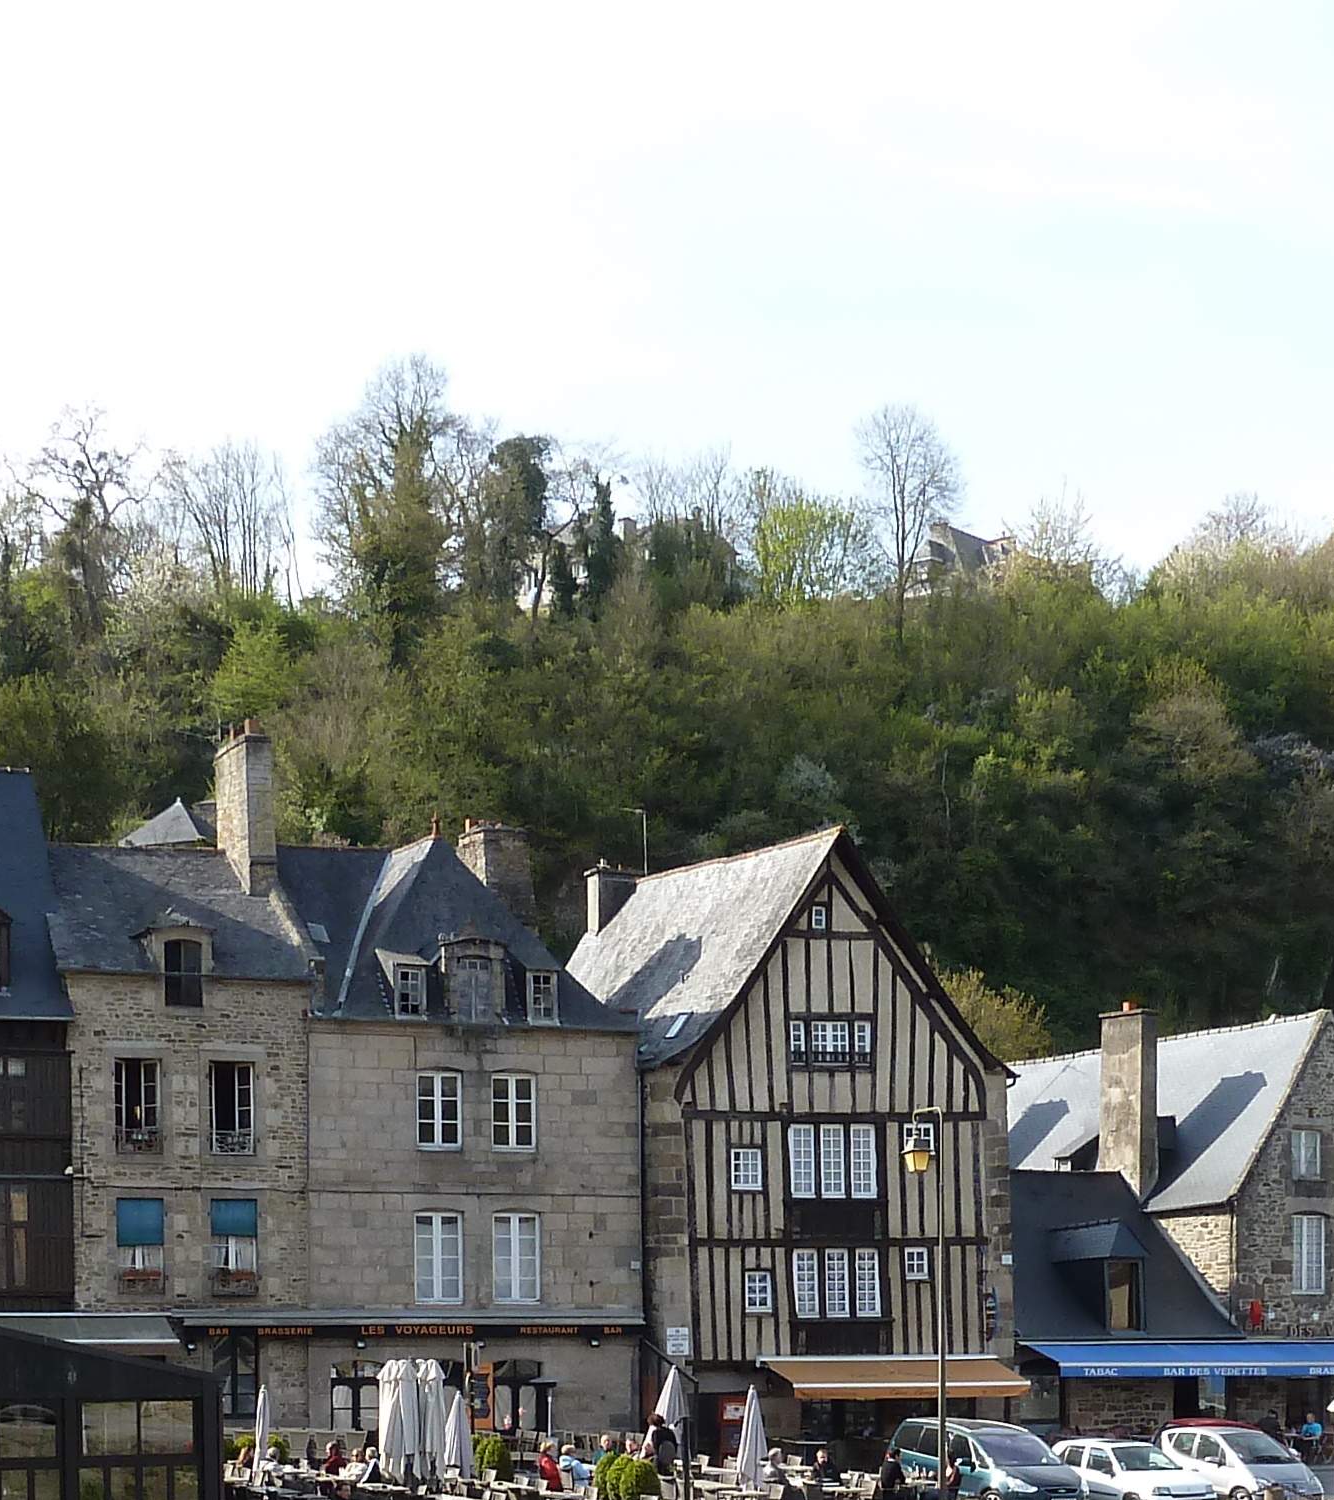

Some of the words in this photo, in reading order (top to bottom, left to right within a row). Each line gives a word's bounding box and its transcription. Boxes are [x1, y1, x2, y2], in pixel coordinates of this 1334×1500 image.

[208, 1327, 230, 1336] BAR
[257, 1327, 314, 1336] BRASSERIE
[361, 1325, 386, 1335] LES
[395, 1325, 474, 1335] VOYAGEURS
[519, 1326, 579, 1335] RESTAURANT
[603, 1326, 623, 1335] BAR
[1289, 1324, 1313, 1338] DES
[1083, 1367, 1118, 1376] TABAC
[1164, 1367, 1186, 1376] BAR
[1189, 1367, 1211, 1376] DES
[1214, 1367, 1268, 1376] VEDETTES
